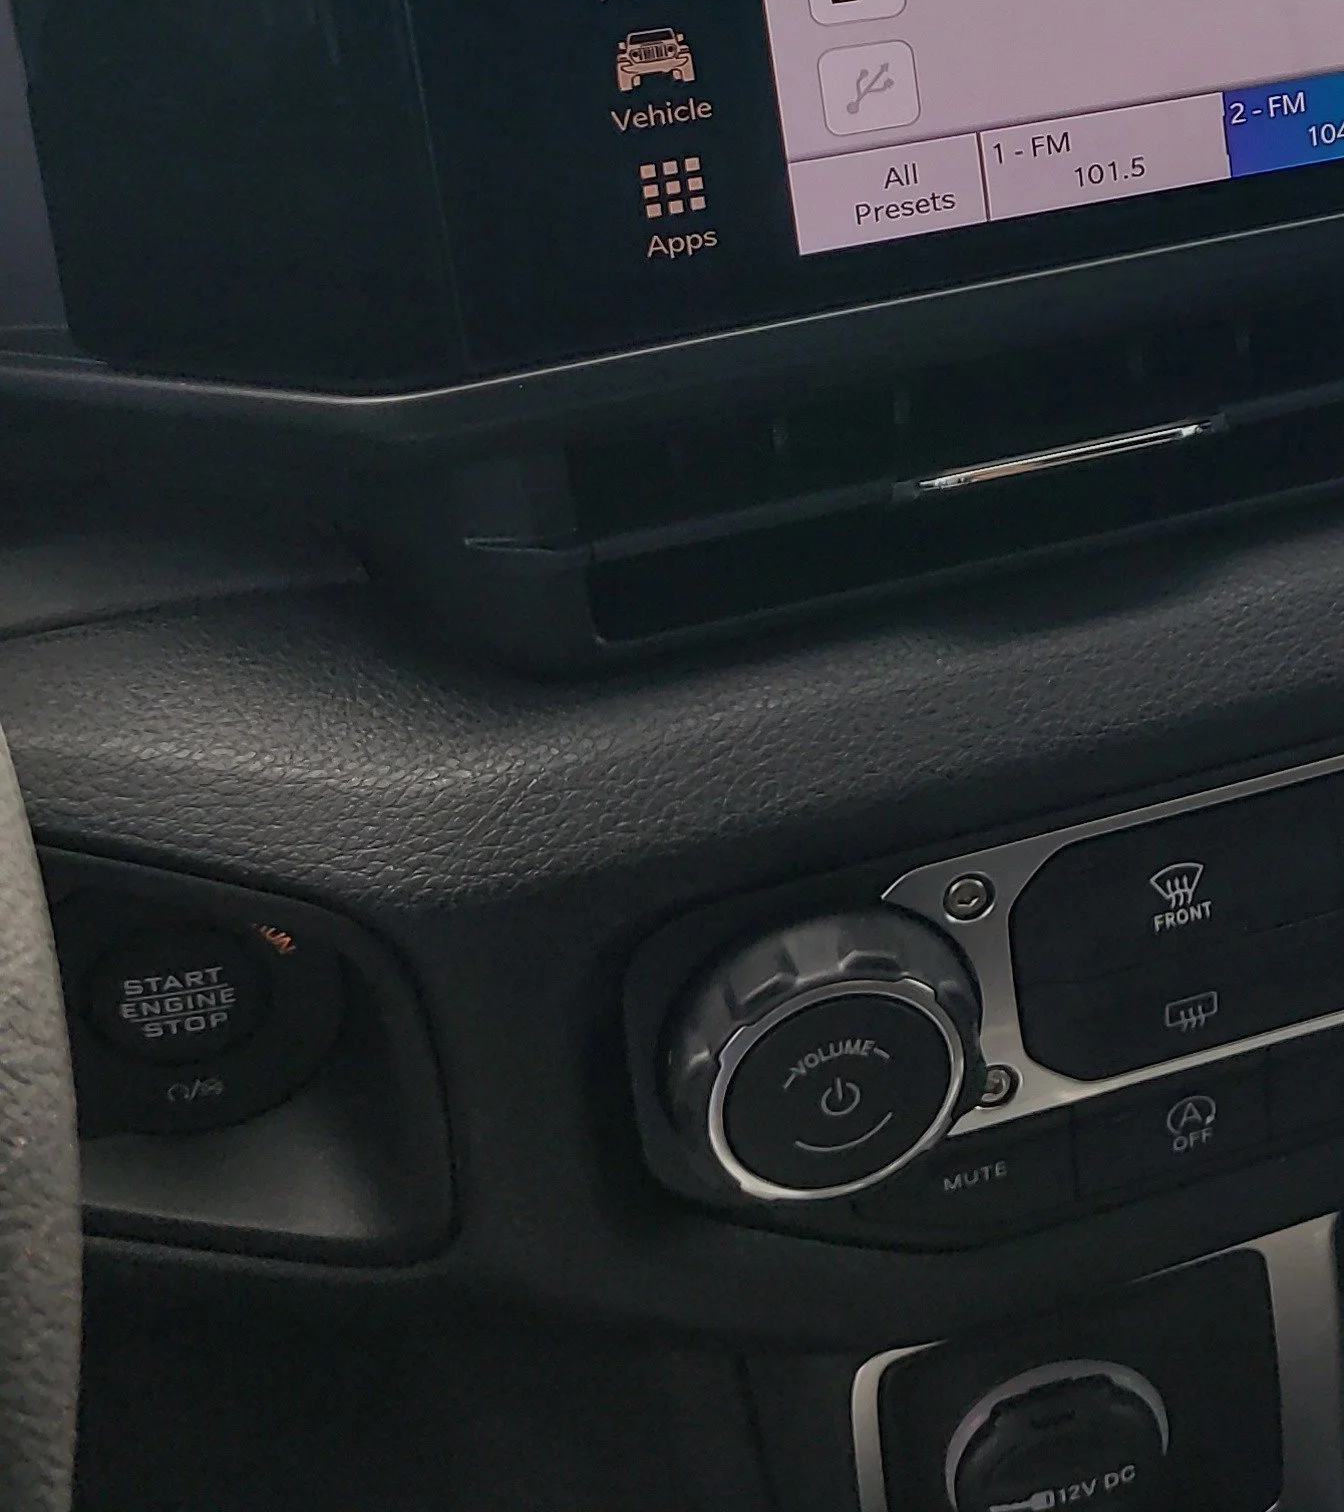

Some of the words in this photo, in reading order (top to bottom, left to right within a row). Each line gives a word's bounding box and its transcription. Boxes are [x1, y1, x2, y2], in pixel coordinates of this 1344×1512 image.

[611, 95, 713, 132] Vehicle
[1230, 101, 1245, 125] 2
[1266, 92, 1307, 118] FM
[992, 141, 1004, 165] 1
[1031, 130, 1072, 157] FM
[884, 163, 919, 189] All
[1073, 156, 1147, 188] 101.5
[854, 190, 957, 226] Presets
[646, 225, 718, 260] Apps
[1153, 900, 1213, 932] FRONT
[123, 965, 224, 997] START
[119, 987, 237, 1020] ENGINE
[143, 1010, 229, 1039] STOP
[797, 1039, 876, 1076] VOLUME
[1172, 1127, 1214, 1153] OFF
[943, 1161, 1008, 1192] MUTE
[1057, 1477, 1096, 1504] 12V
[1104, 1464, 1136, 1490] DC
